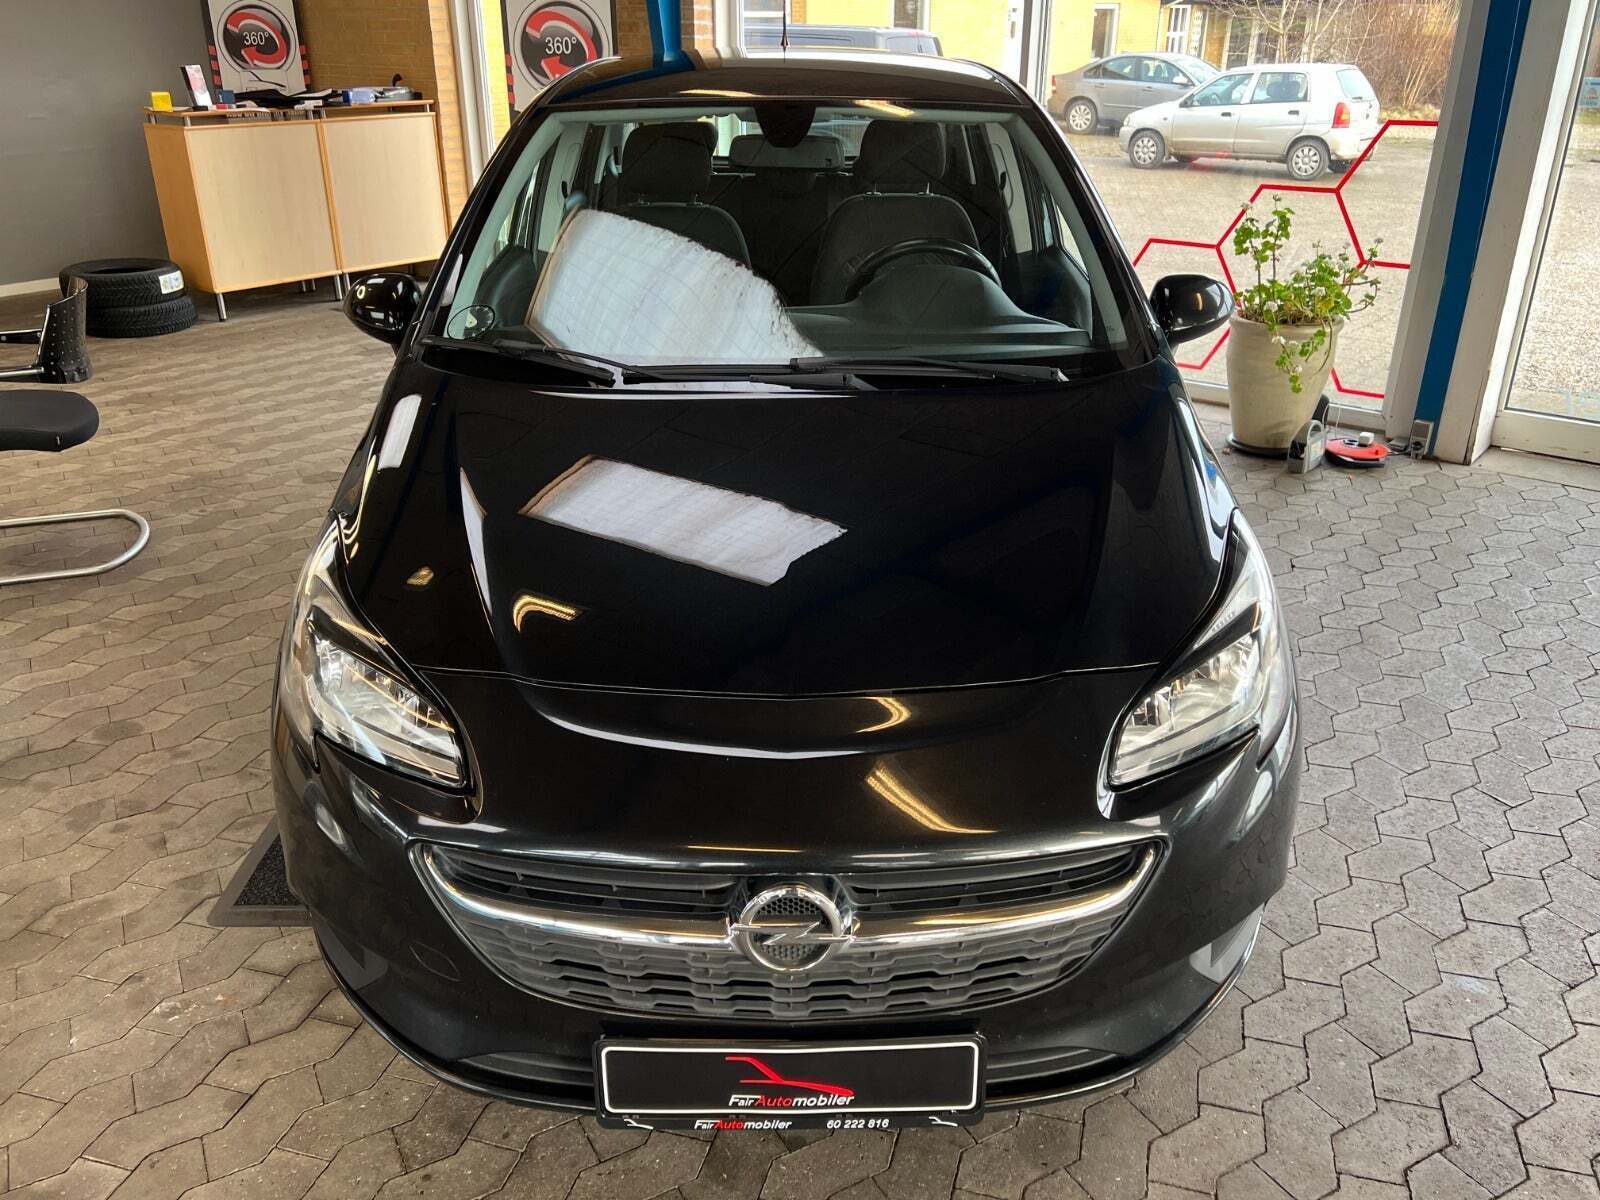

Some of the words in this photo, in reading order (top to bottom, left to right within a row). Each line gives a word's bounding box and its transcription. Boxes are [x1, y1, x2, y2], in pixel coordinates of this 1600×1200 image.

[243, 31, 269, 45] 360°
[545, 36, 577, 54] 360°
[728, 1094, 854, 1107] FairAutomobiler
[826, 1119, 841, 1129] 60
[843, 1119, 865, 1129] 222
[867, 1118, 890, 1128] 816
